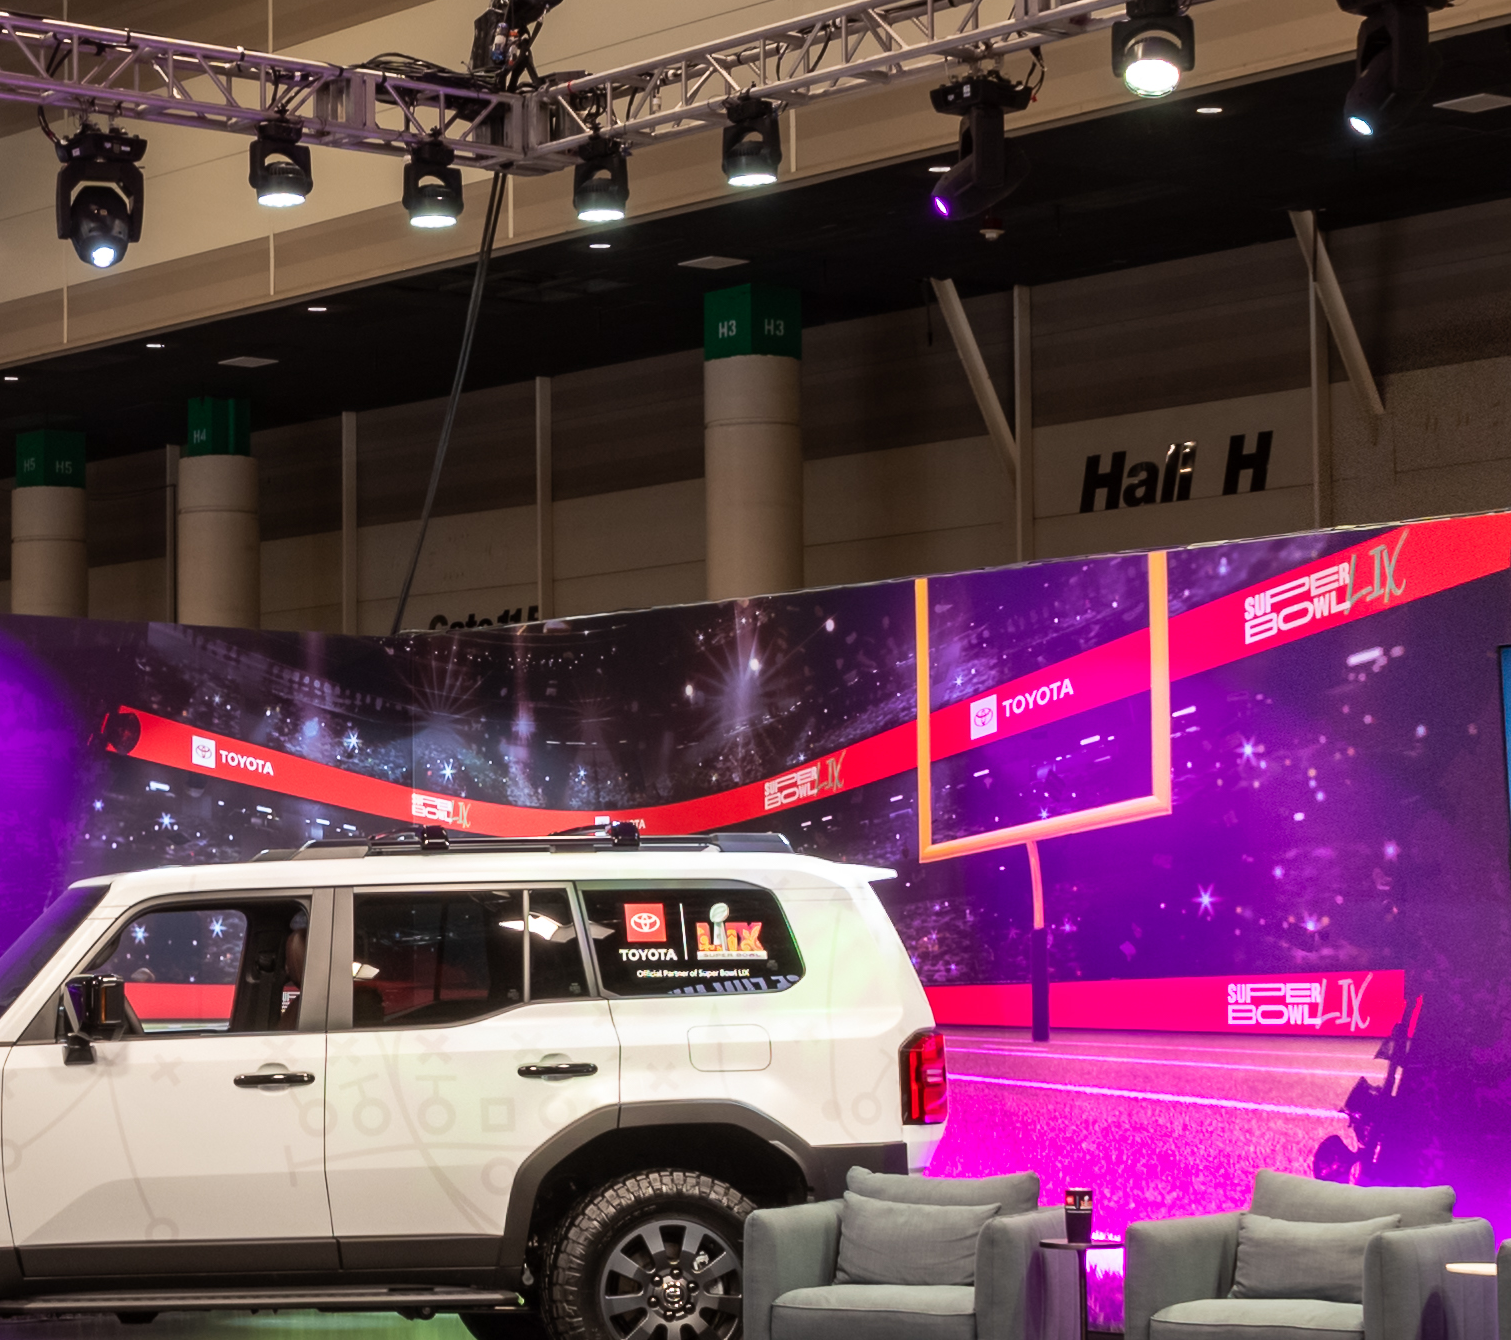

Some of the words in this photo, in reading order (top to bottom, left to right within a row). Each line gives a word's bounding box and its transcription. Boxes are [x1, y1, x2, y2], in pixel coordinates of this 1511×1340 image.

[718, 320, 737, 339] H3
[764, 319, 785, 336] H3
[193, 429, 208, 444] H4
[23, 459, 36, 472] H5
[54, 461, 74, 475] H5
[1079, 441, 1197, 514] Hall
[1222, 430, 1273, 496] H
[1244, 562, 1350, 621] SUPER
[1345, 529, 1410, 615] LIX
[1244, 591, 1352, 645] BOWL
[1001, 678, 1075, 718] TOYOTA
[220, 749, 274, 777] TOYOTA
[765, 766, 818, 796] SUPER
[815, 748, 846, 797] LIX
[765, 781, 817, 810] BOWL
[696, 921, 763, 952] LIX
[619, 948, 678, 961] TOYOTA
[637, 969, 662, 978] Official
[664, 969, 688, 977] Partner
[690, 968, 697, 977] of
[699, 968, 719, 979] Super
[720, 968, 738, 977] Bowl
[739, 968, 750, 976] LIX
[1228, 983, 1321, 1004] SUPER
[1315, 971, 1373, 1032] LIX
[1228, 1004, 1322, 1025] BOWL
